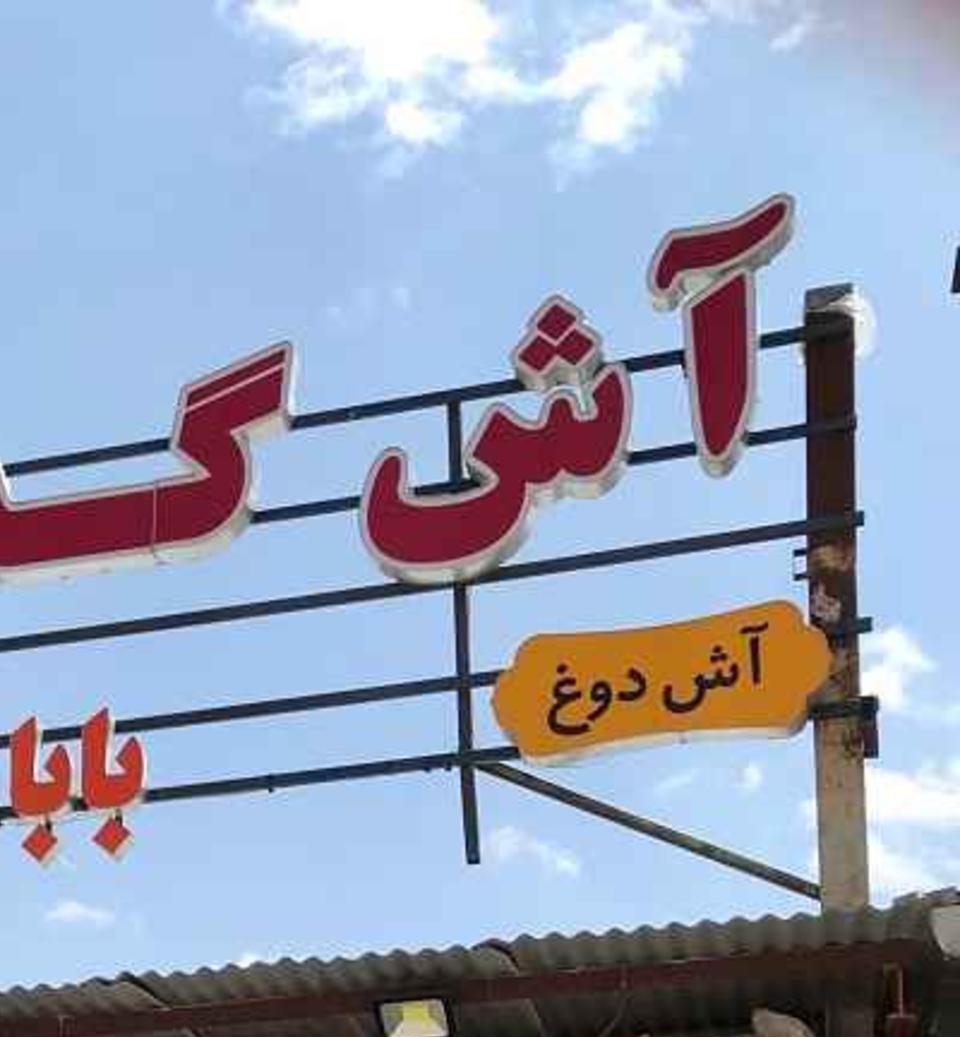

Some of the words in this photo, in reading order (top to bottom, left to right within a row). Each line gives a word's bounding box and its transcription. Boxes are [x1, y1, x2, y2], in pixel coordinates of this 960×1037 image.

[360, 193, 795, 582] آش
[547, 664, 647, 735] دوغ
[662, 621, 768, 714] آش
[9, 706, 148, 863] بابا
